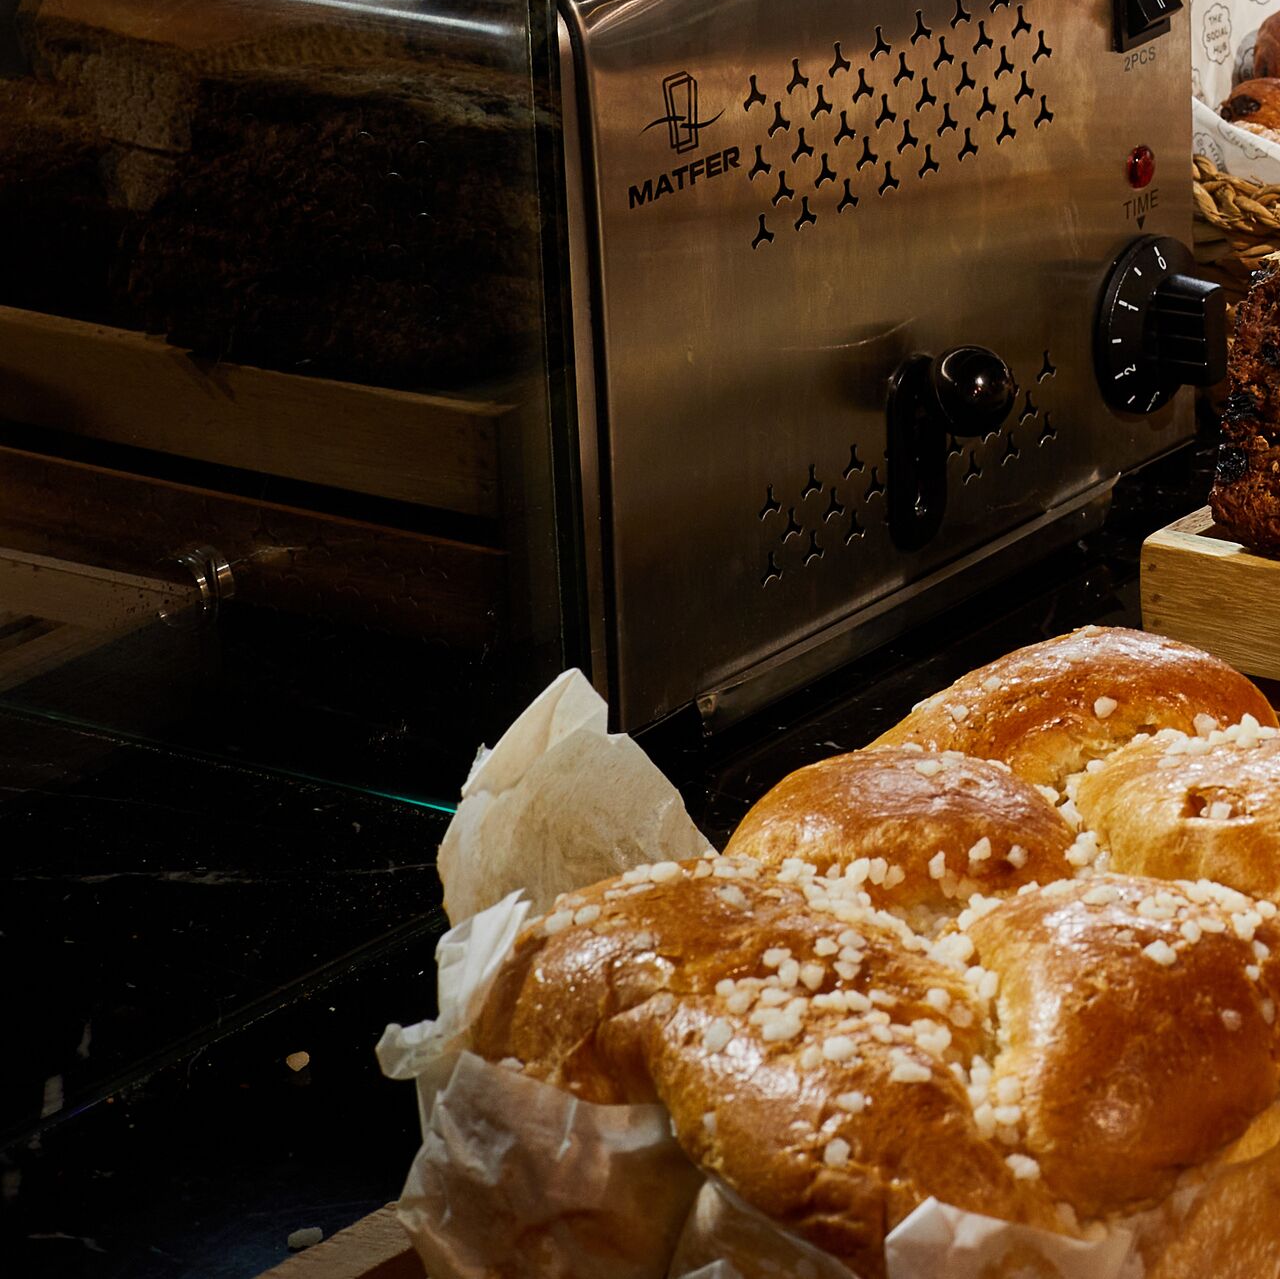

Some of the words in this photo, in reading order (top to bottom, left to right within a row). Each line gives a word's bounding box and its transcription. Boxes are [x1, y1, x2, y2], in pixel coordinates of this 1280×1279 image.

[1208, 13, 1223, 24] THE
[1205, 28, 1229, 43] SOCIAL
[1212, 42, 1228, 54] HUB
[1123, 46, 1157, 73] 2PCS
[628, 145, 742, 210] MATFER
[1122, 188, 1160, 220] TIME
